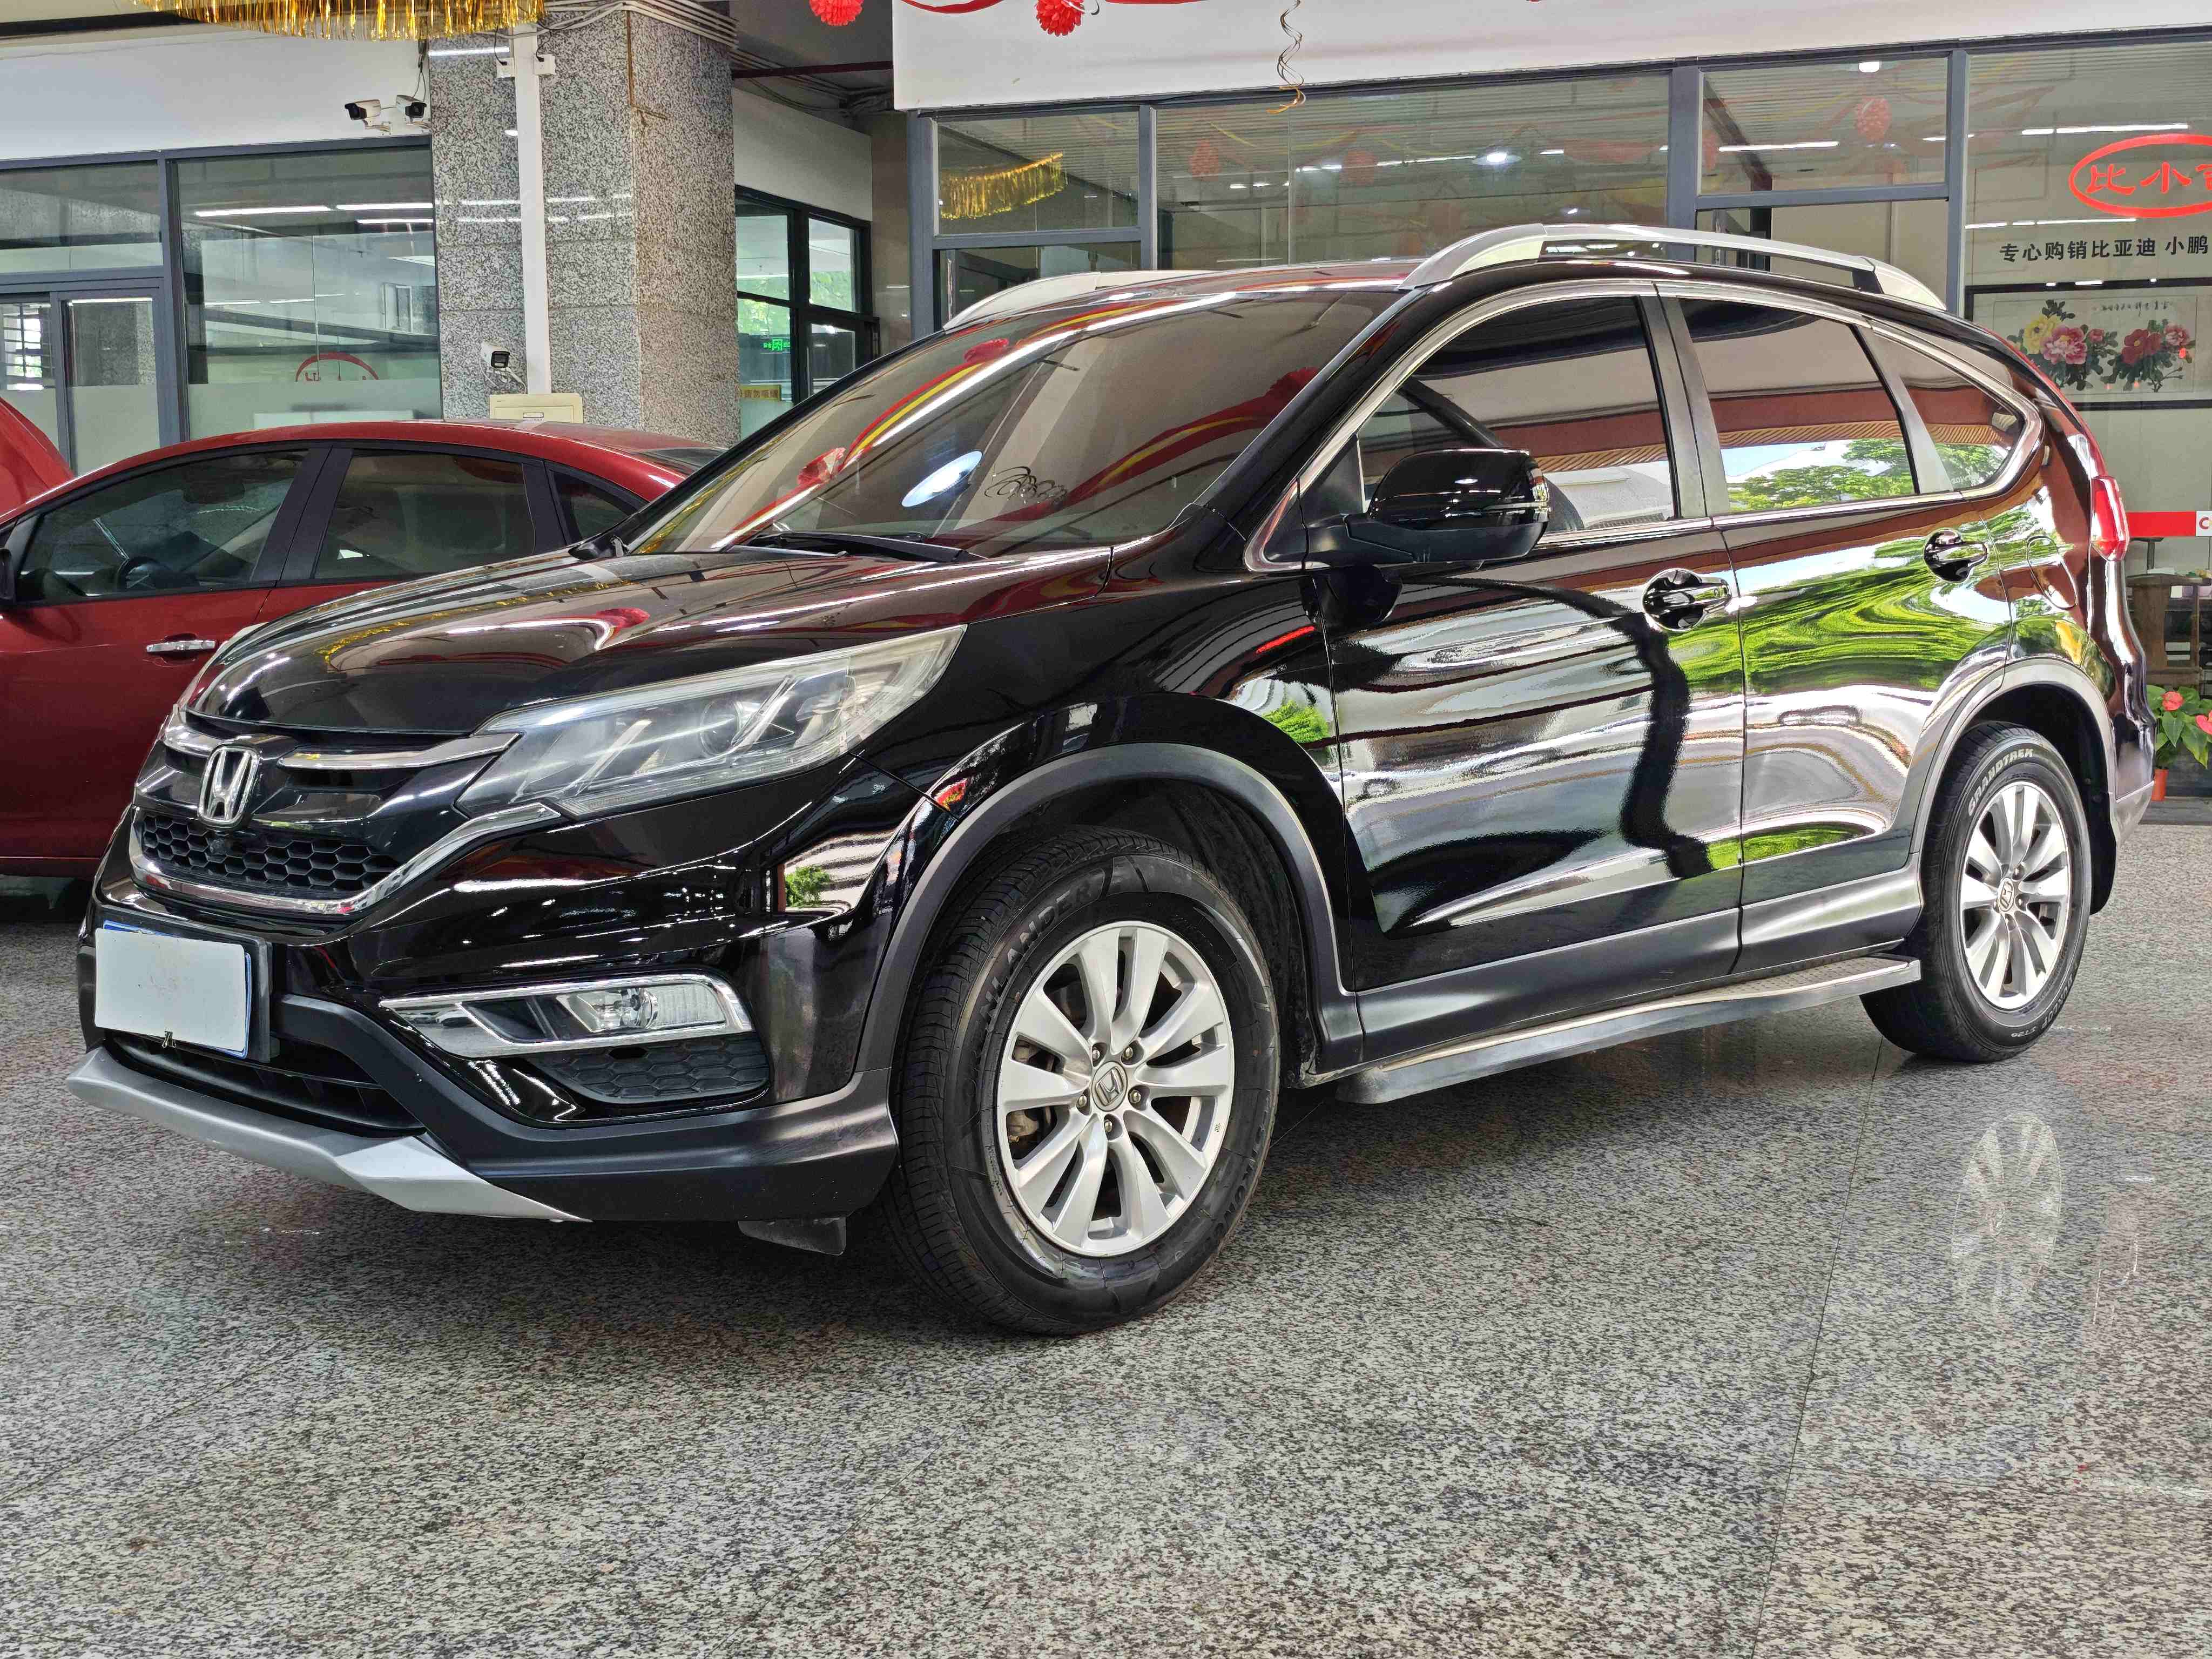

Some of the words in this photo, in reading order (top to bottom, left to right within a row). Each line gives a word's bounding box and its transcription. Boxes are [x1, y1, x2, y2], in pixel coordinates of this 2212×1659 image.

[2000, 238, 2156, 262] 专心购销比亚迪
[2164, 234, 2208, 255] 小鹏
[1968, 748, 2034, 817] GRANDTREK
